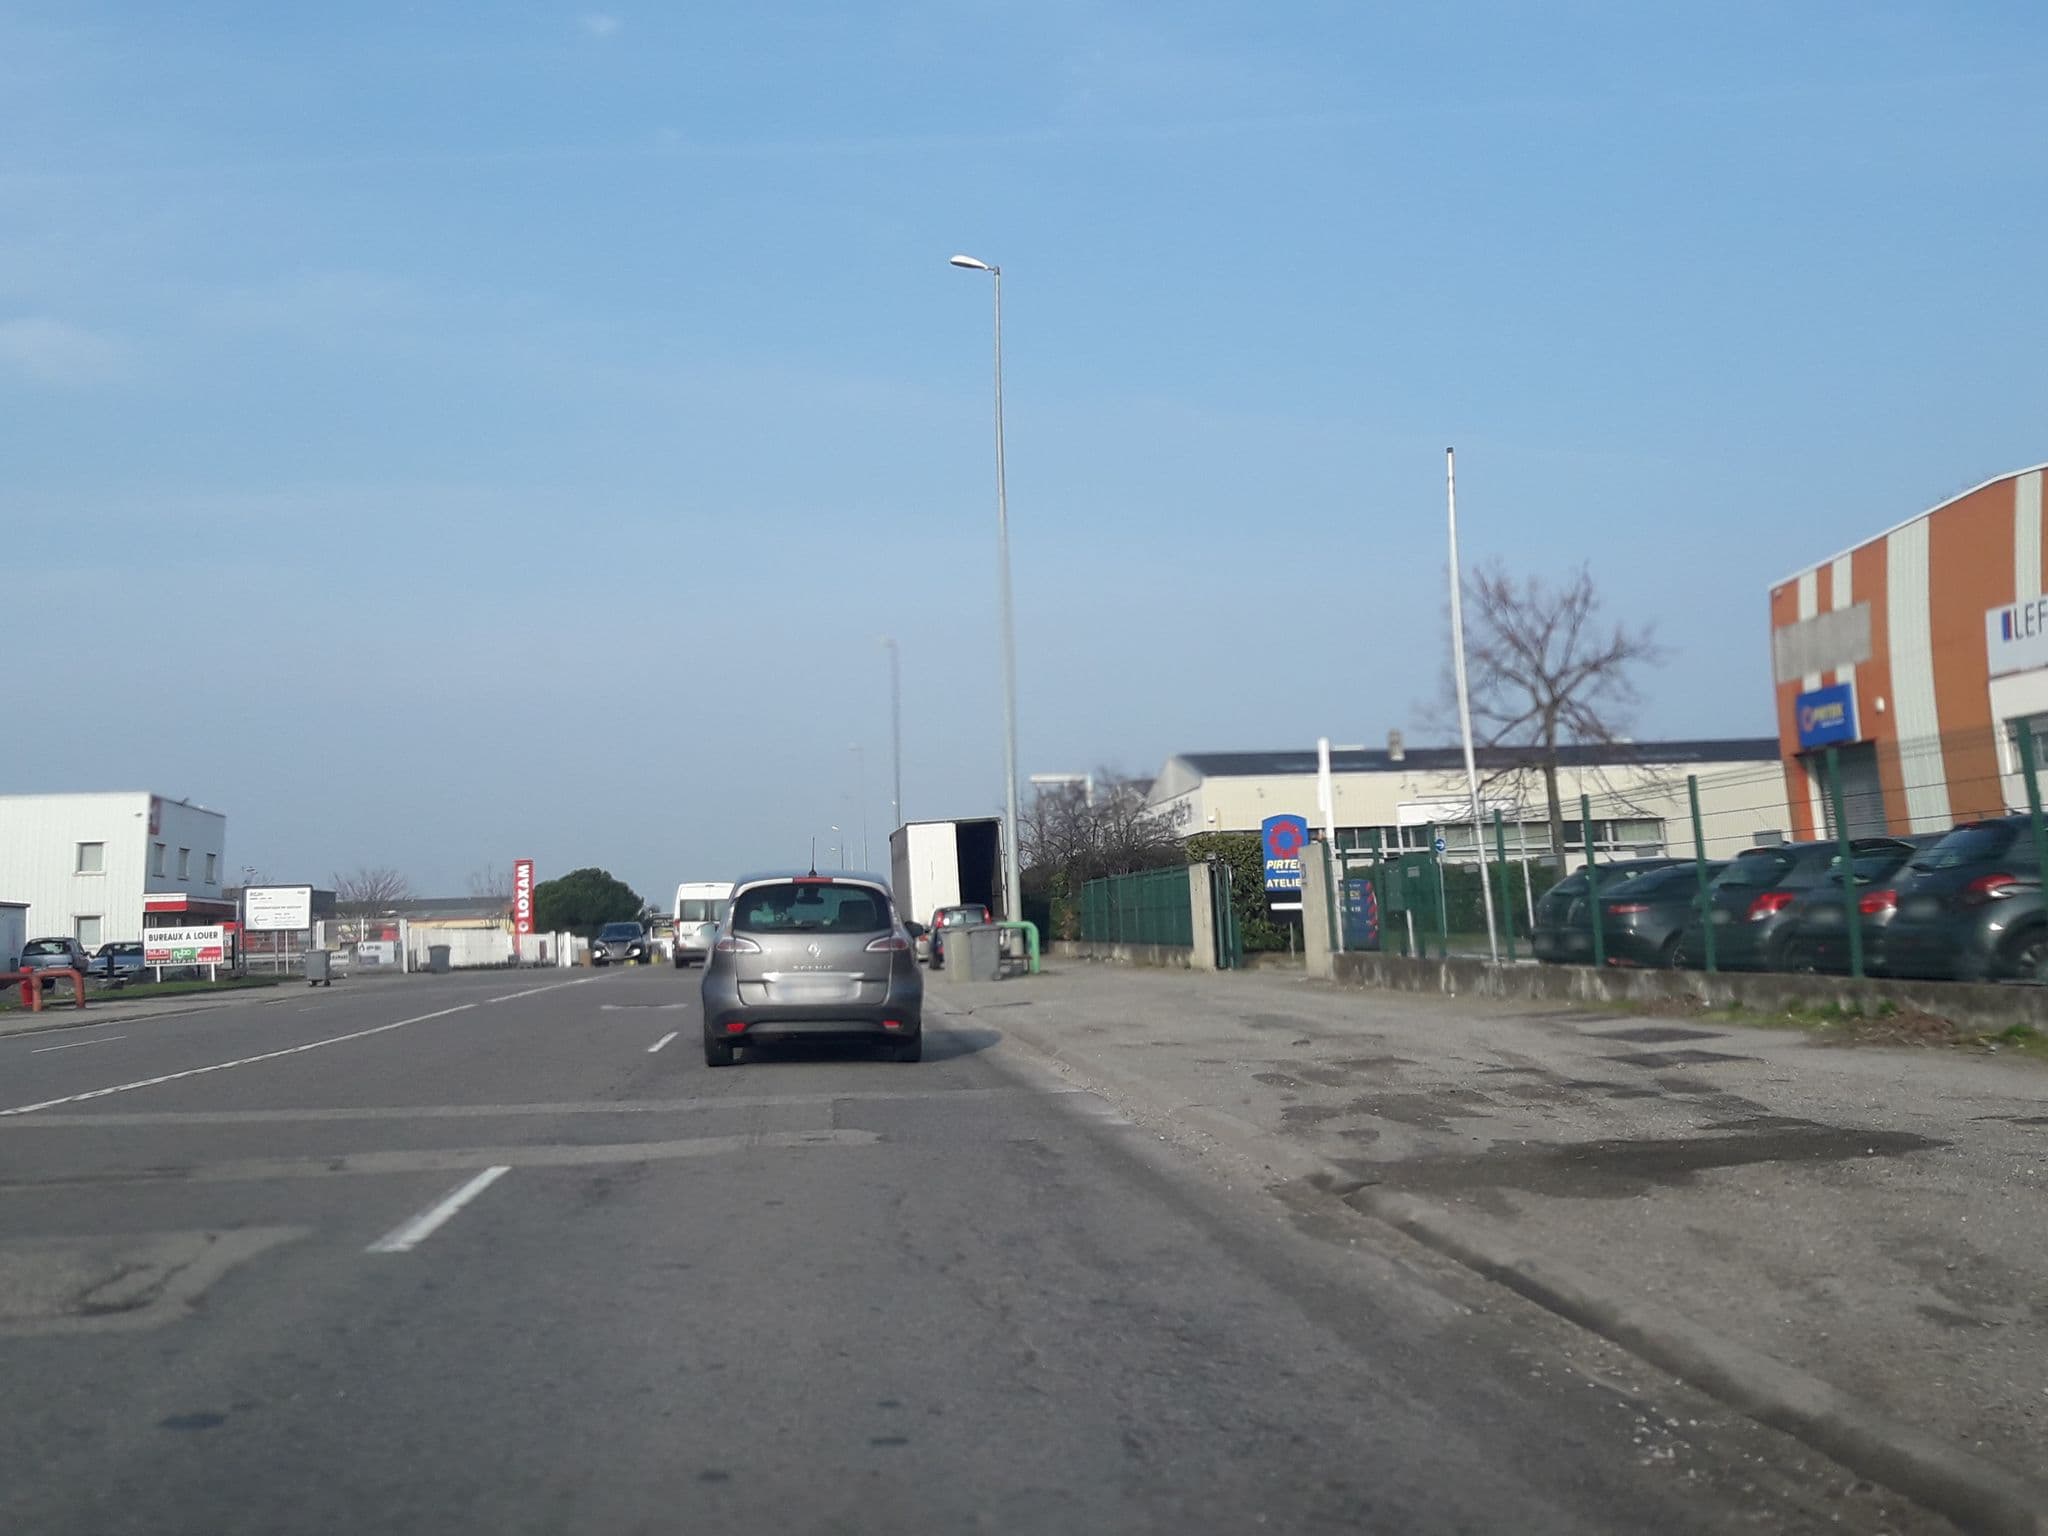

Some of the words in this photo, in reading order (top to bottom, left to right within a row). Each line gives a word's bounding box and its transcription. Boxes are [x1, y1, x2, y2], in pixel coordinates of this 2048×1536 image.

[517, 864, 530, 918] LOXAM
[148, 932, 183, 942] BUREAUX
[185, 932, 192, 940] A
[194, 931, 219, 940] LOUER
